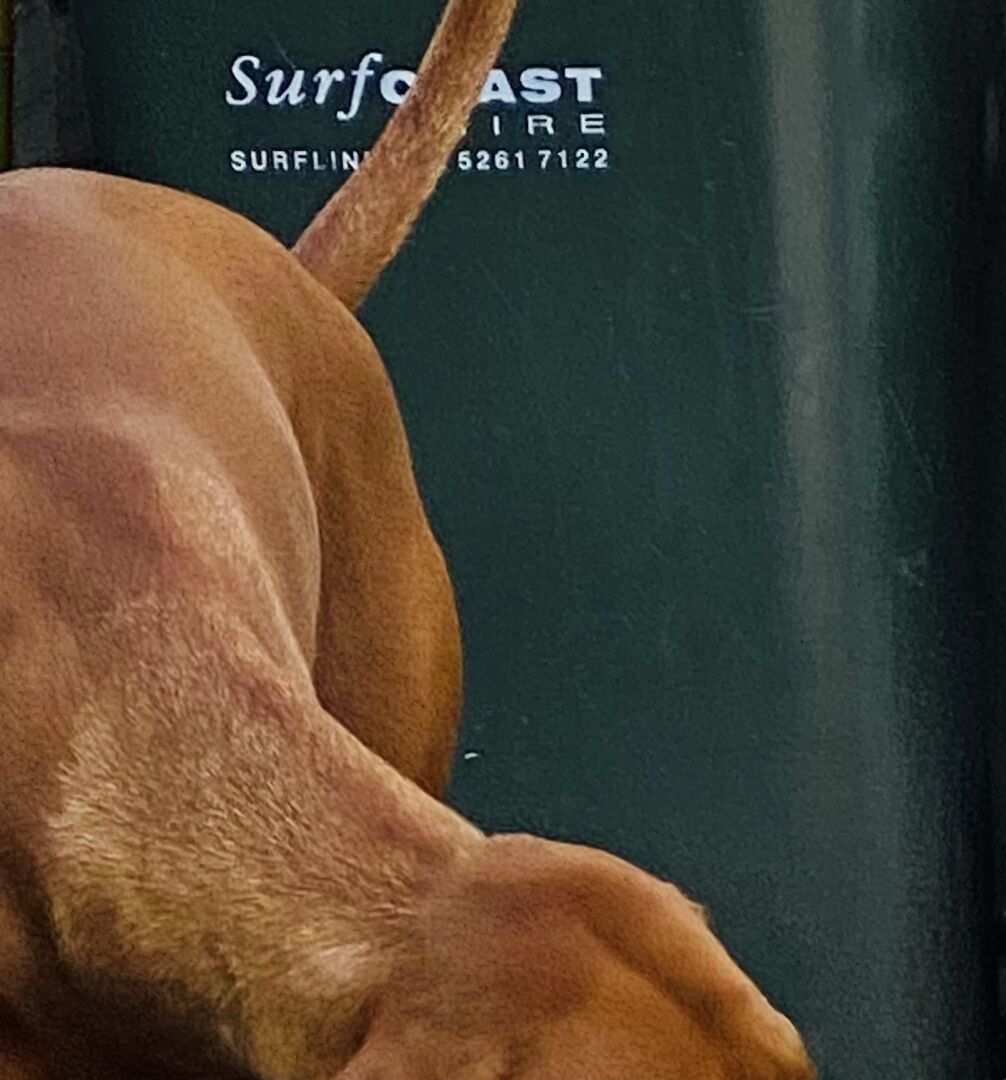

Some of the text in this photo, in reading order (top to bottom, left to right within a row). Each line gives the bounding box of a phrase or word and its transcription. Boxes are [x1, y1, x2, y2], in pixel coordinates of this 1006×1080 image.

[230, 148, 609, 172] SURFLIN 5261 7122
